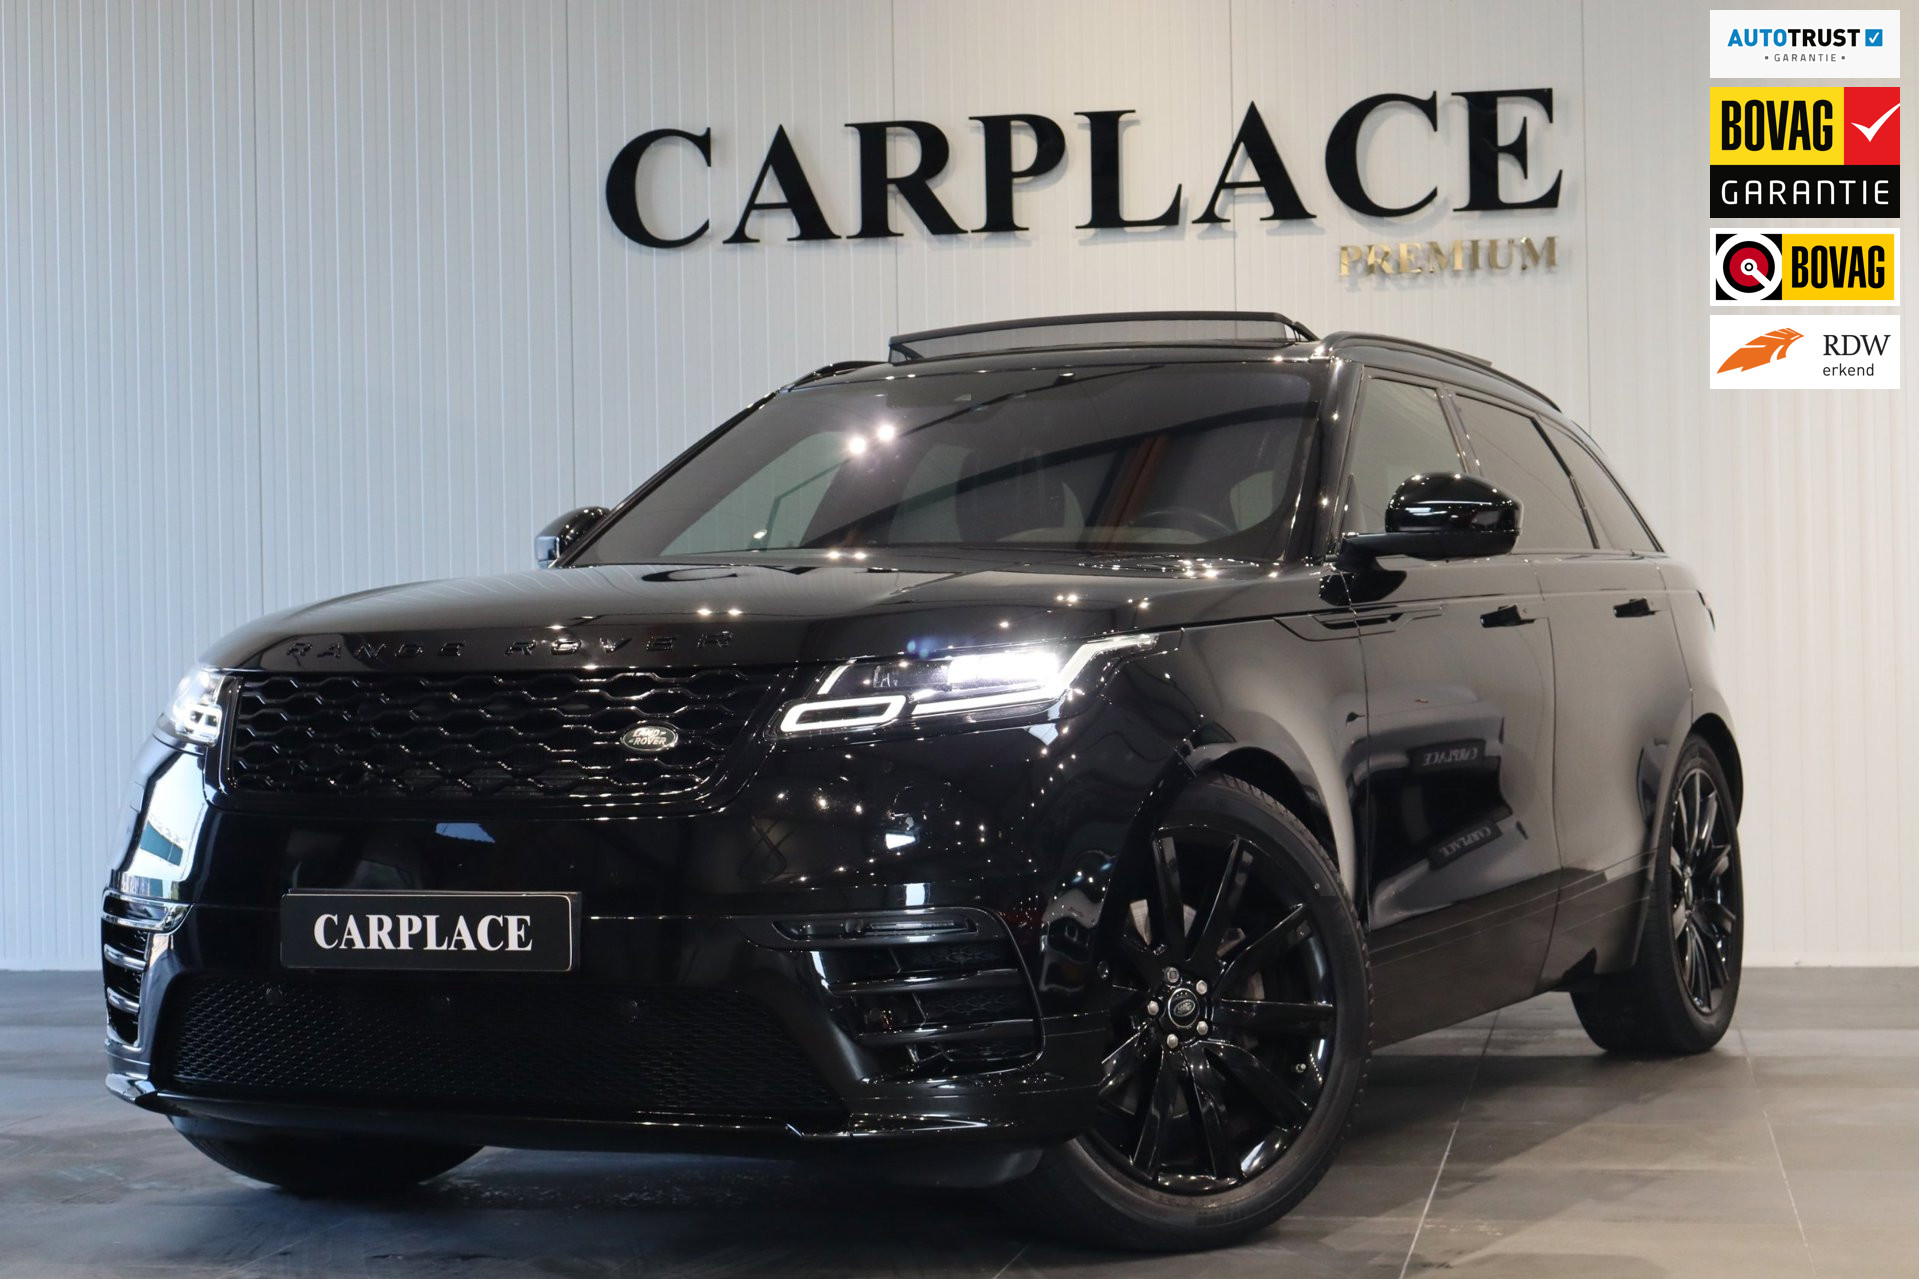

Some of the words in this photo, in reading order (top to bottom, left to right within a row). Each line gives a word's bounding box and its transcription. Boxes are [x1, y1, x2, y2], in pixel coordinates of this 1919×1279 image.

[605, 87, 1563, 249] CARPLACE
[1338, 235, 1559, 280] PREMIUM
[286, 639, 467, 659] RANGE
[504, 630, 735, 657] ROVER
[632, 726, 660, 737] LAND
[633, 736, 667, 746] ROVER
[313, 913, 533, 952] CARPLACE
